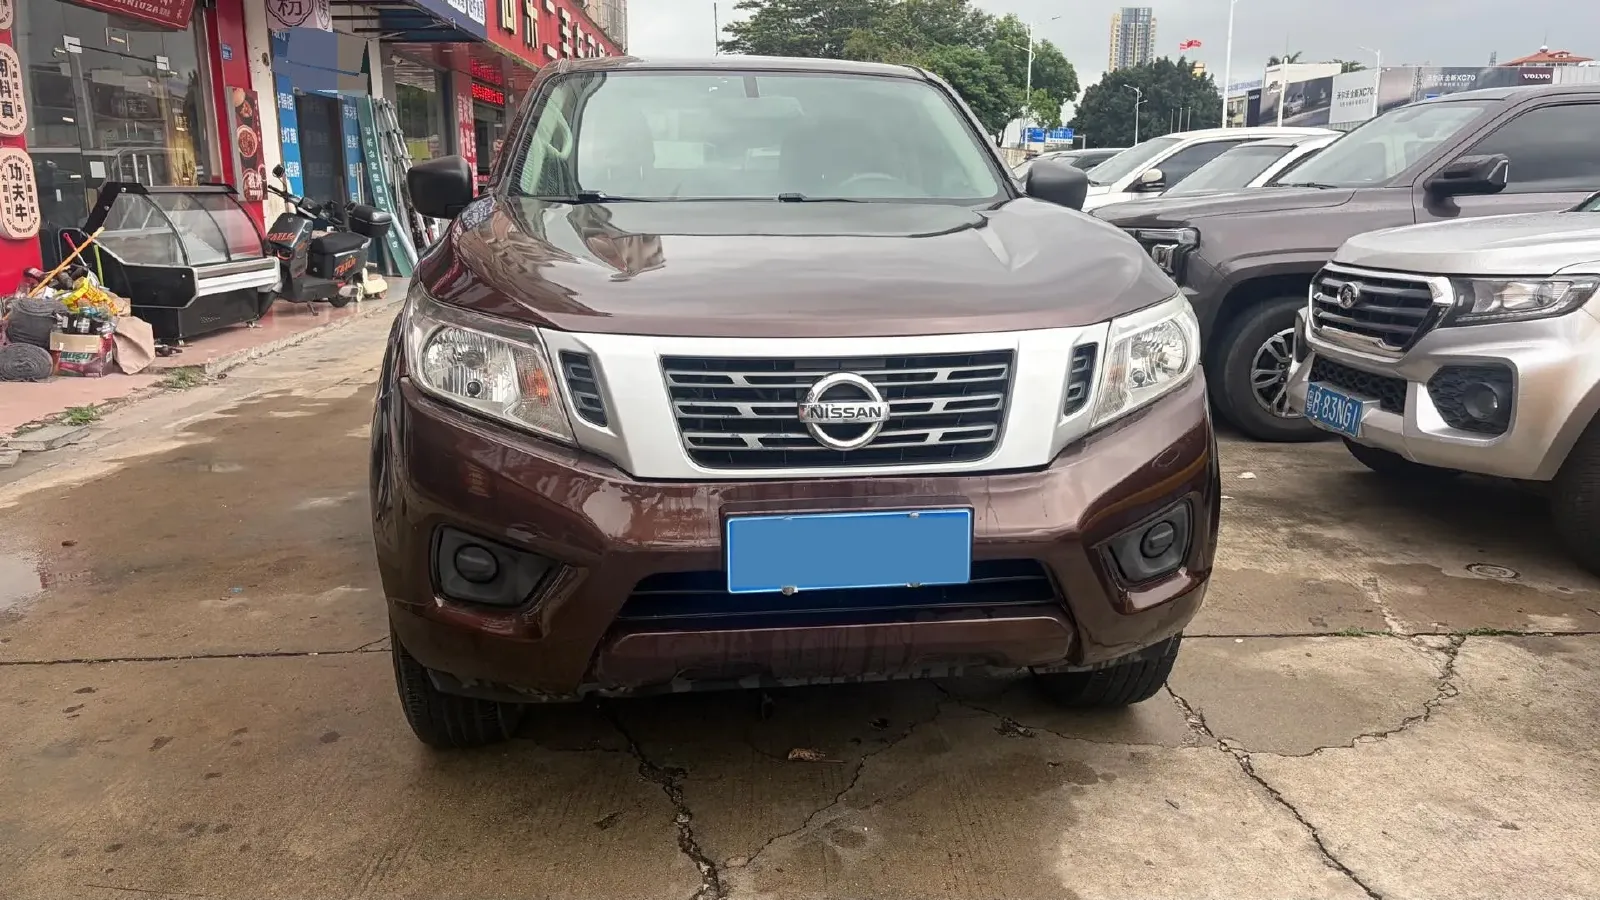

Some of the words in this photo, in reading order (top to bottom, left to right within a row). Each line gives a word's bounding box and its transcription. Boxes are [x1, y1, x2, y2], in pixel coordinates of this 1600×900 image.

[8, 163, 27, 222] 功夫牛
[810, 406, 881, 419] NISSAN
